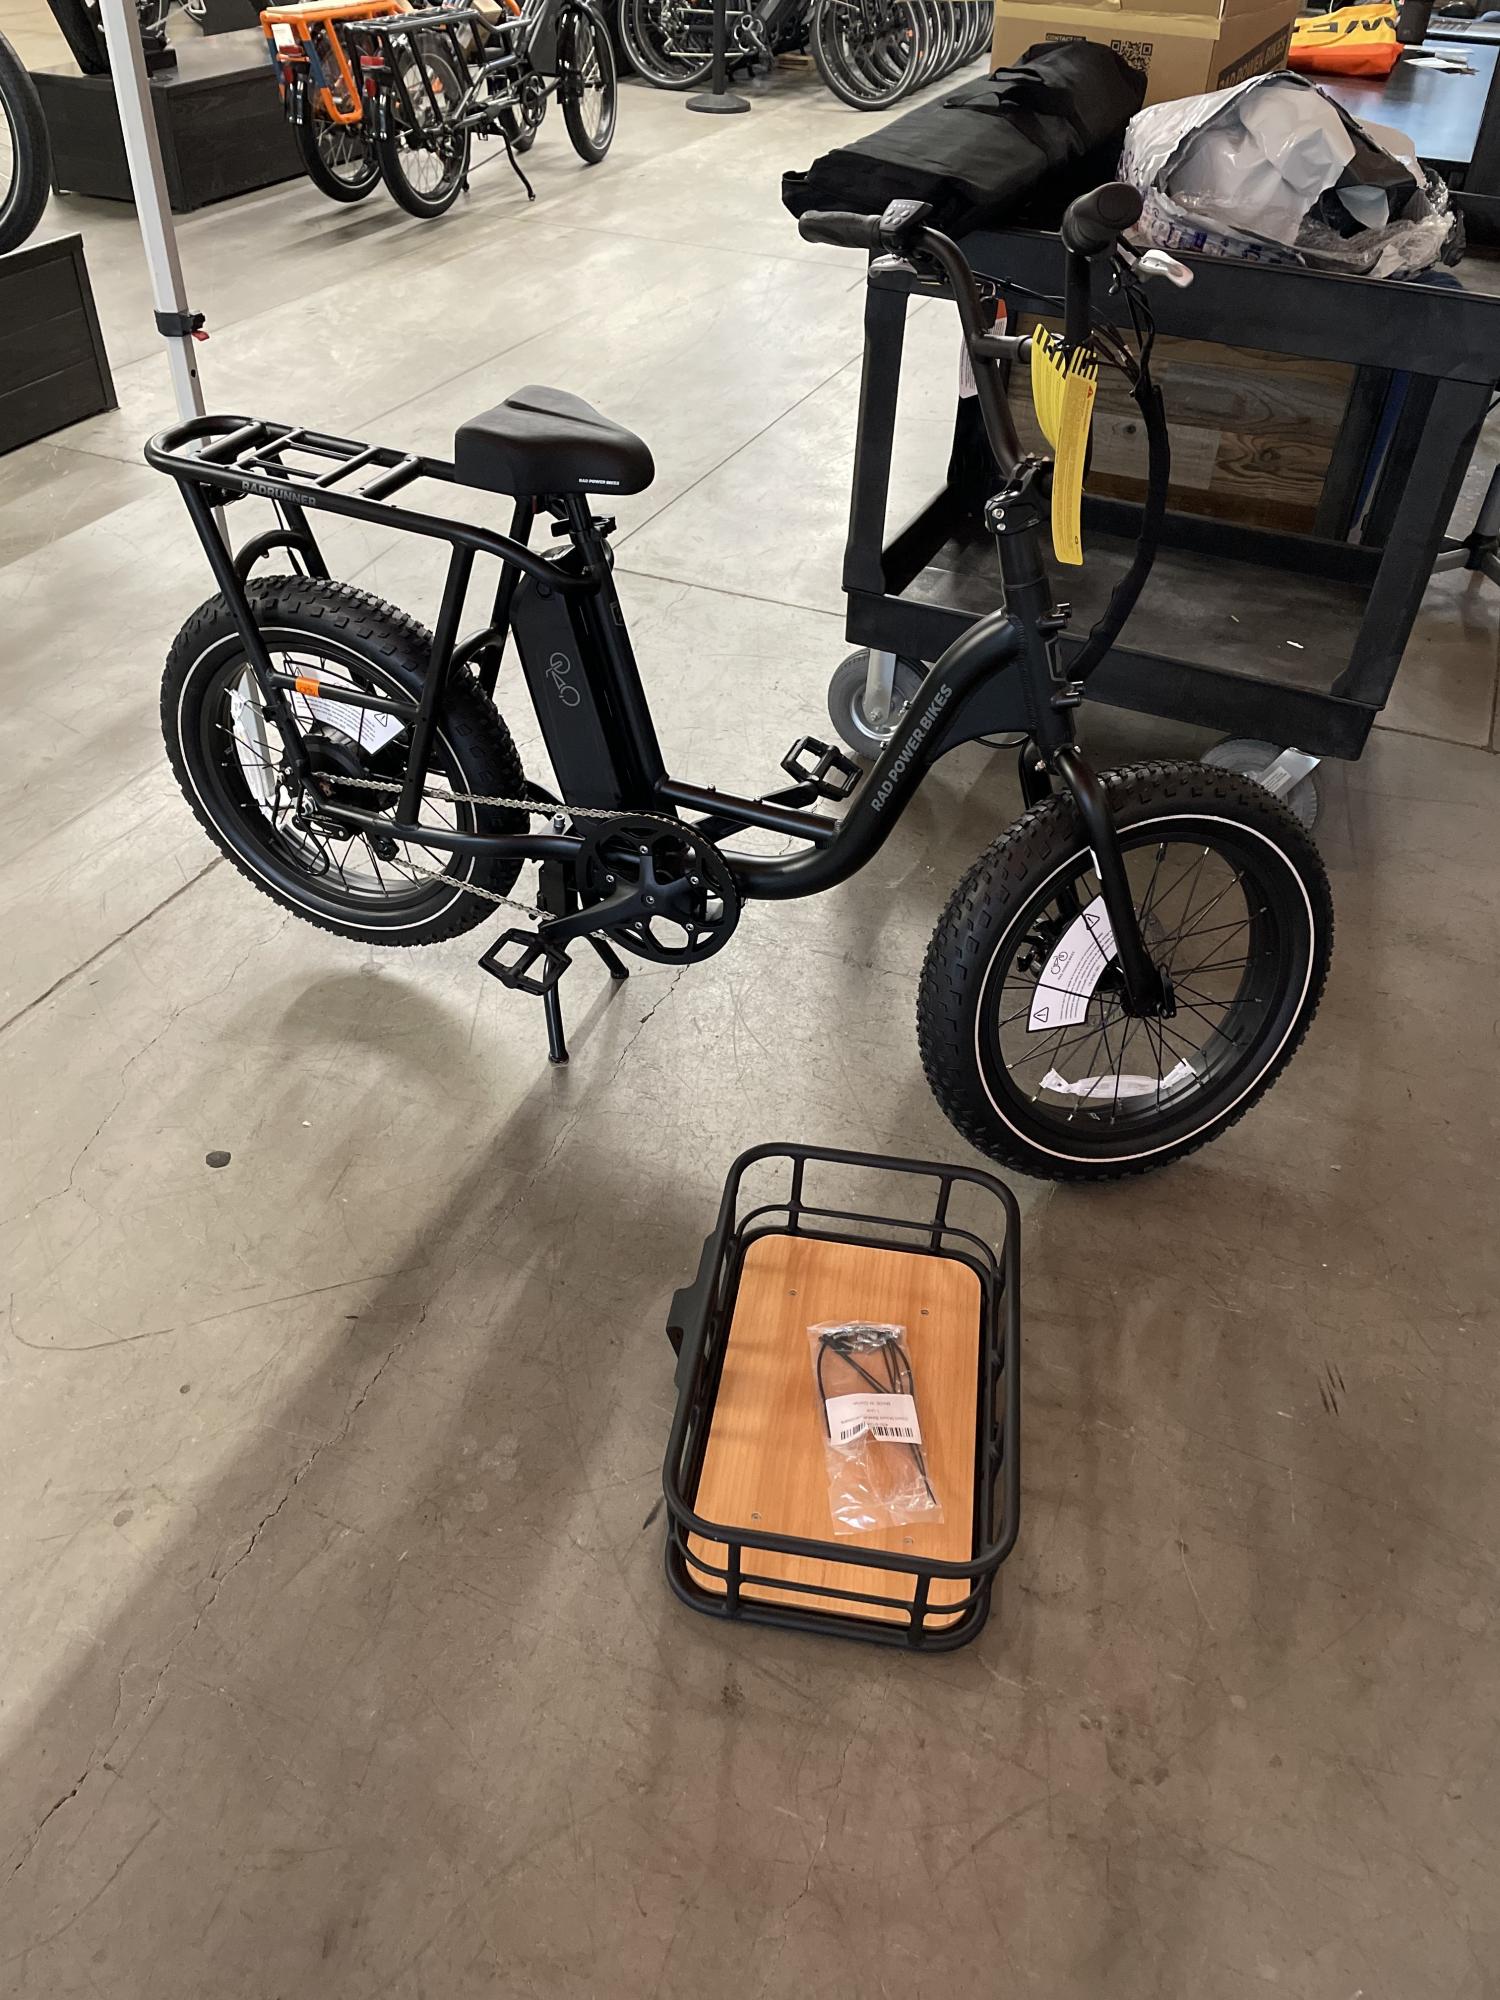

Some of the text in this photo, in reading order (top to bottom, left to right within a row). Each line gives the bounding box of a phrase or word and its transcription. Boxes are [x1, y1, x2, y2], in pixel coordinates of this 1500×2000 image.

[241, 480, 317, 506] RADRUNNER
[870, 683, 953, 812] RAD POWER BIKES
